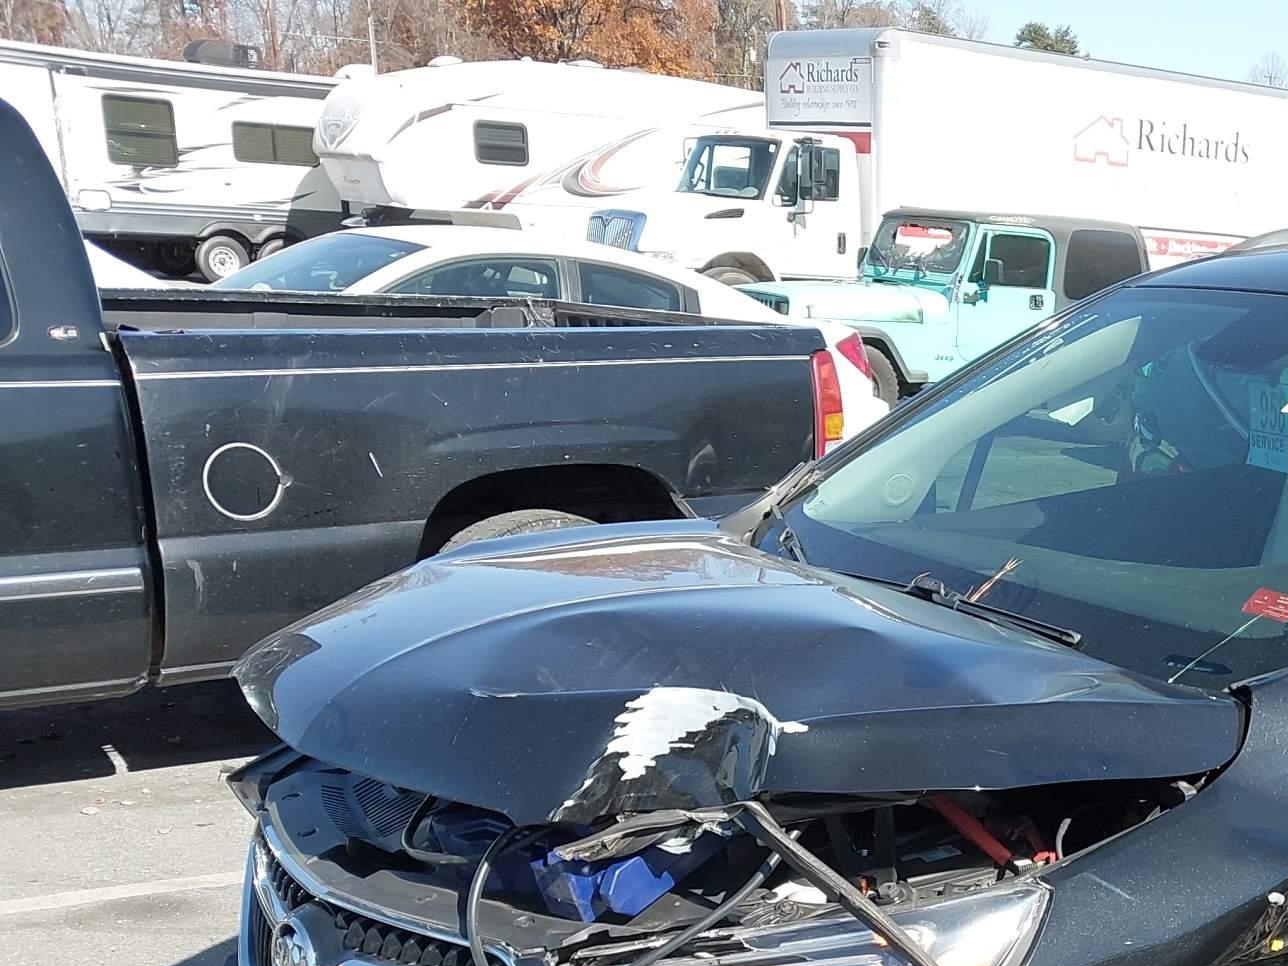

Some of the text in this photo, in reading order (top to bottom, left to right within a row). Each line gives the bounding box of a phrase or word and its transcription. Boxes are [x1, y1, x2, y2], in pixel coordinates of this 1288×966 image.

[807, 62, 859, 82] Richards
[1136, 119, 1250, 164] Richards
[1251, 432, 1285, 452] SERVICE
